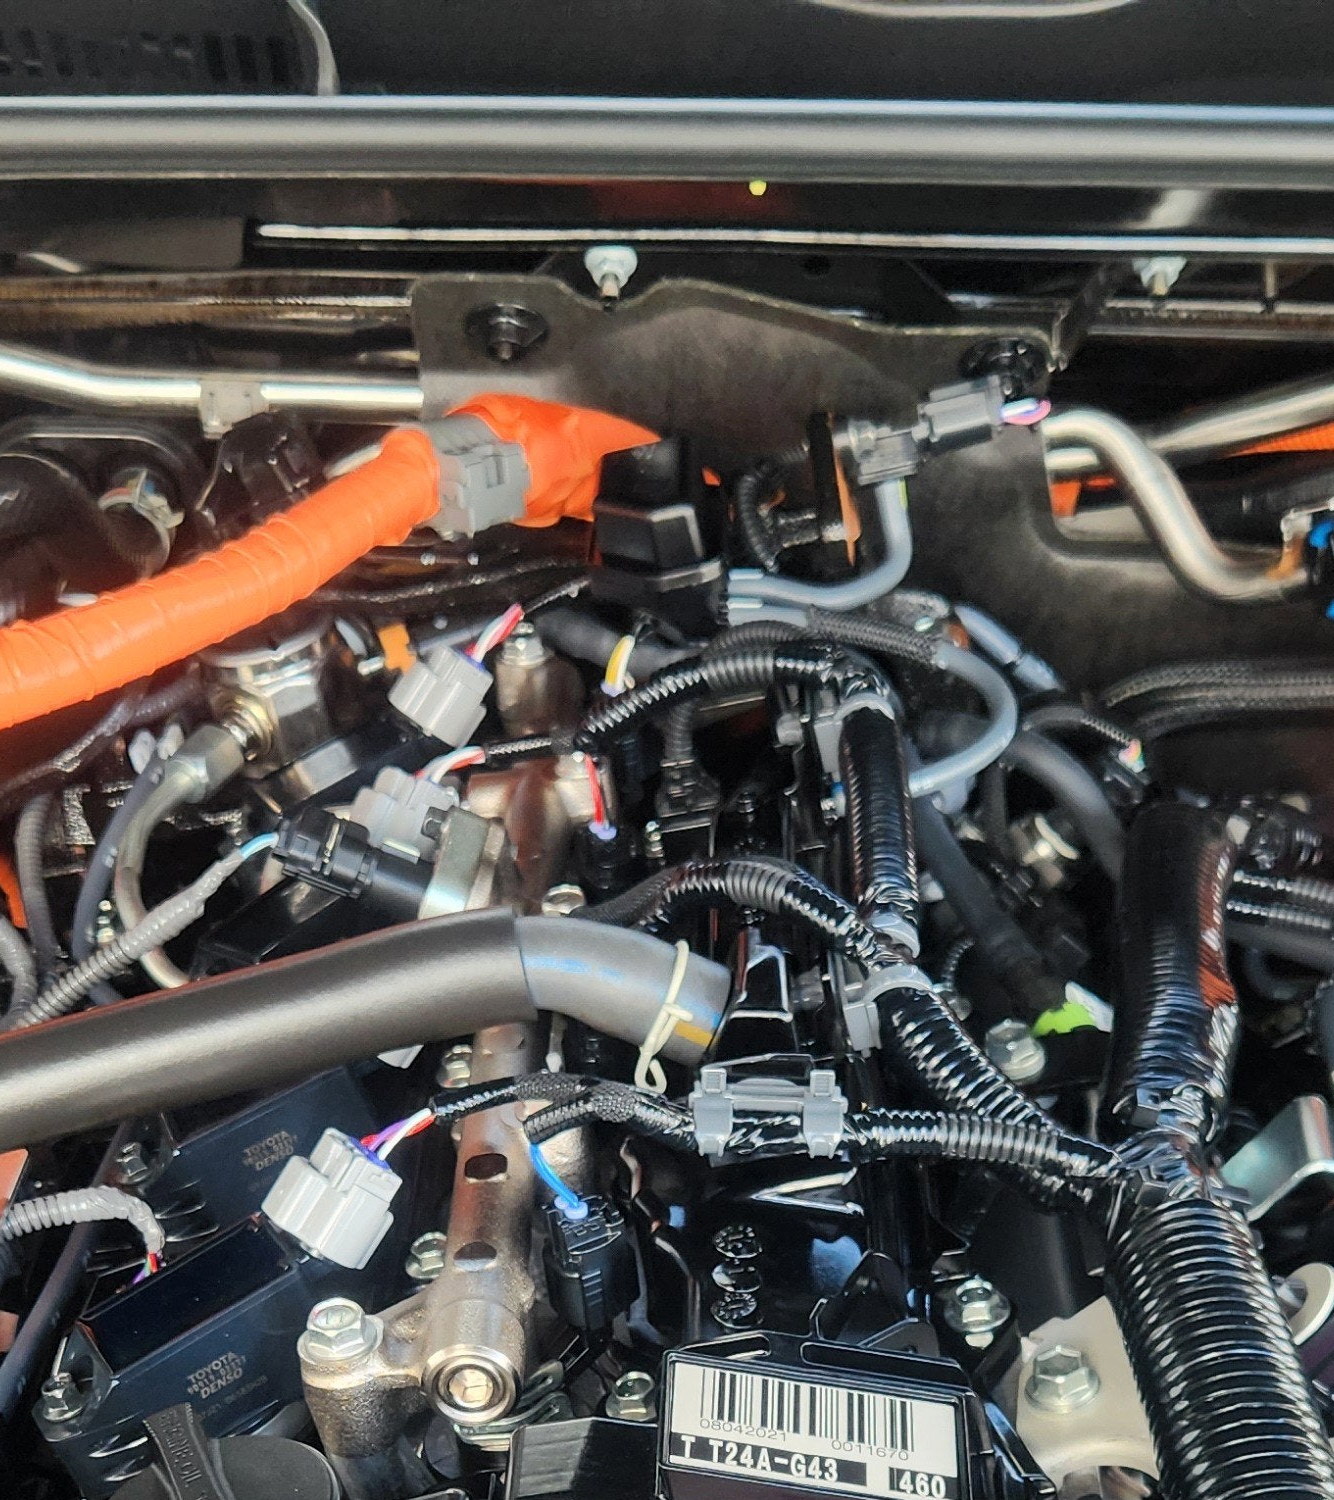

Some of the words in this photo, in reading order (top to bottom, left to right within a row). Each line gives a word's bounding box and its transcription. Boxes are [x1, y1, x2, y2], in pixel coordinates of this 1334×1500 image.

[244, 1131, 290, 1157] TOYOTA
[188, 1352, 237, 1384] TOYOTA
[201, 1368, 243, 1399] DENSO
[700, 1417, 787, 1442] 08042021
[831, 1439, 909, 1461] 0011670
[680, 1434, 696, 1459] T
[709, 1438, 838, 1483] T24A-G43
[898, 1473, 946, 1499] 460
